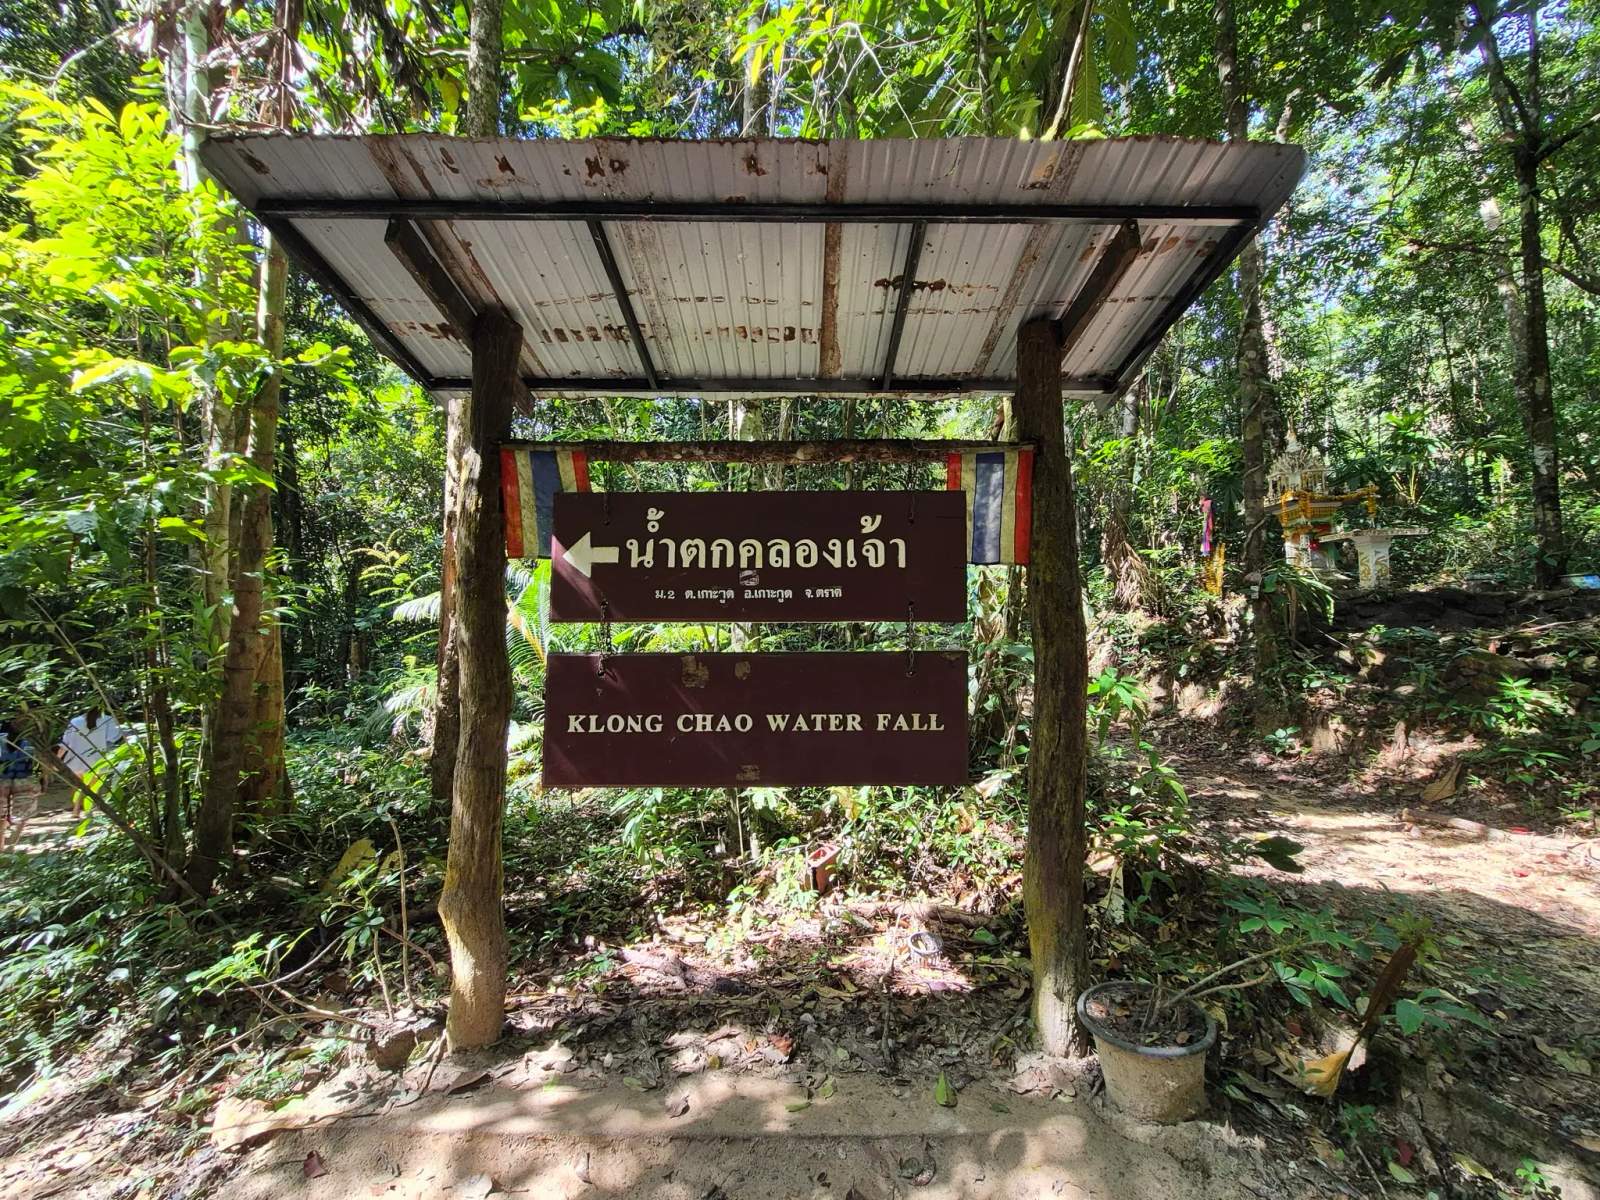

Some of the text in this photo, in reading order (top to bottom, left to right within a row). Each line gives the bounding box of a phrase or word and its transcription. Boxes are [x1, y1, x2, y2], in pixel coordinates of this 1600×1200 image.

[625, 507, 906, 569] น้ำตกคลองเจ้า
[567, 712, 946, 733] KLONG CHAO WATER FALL
